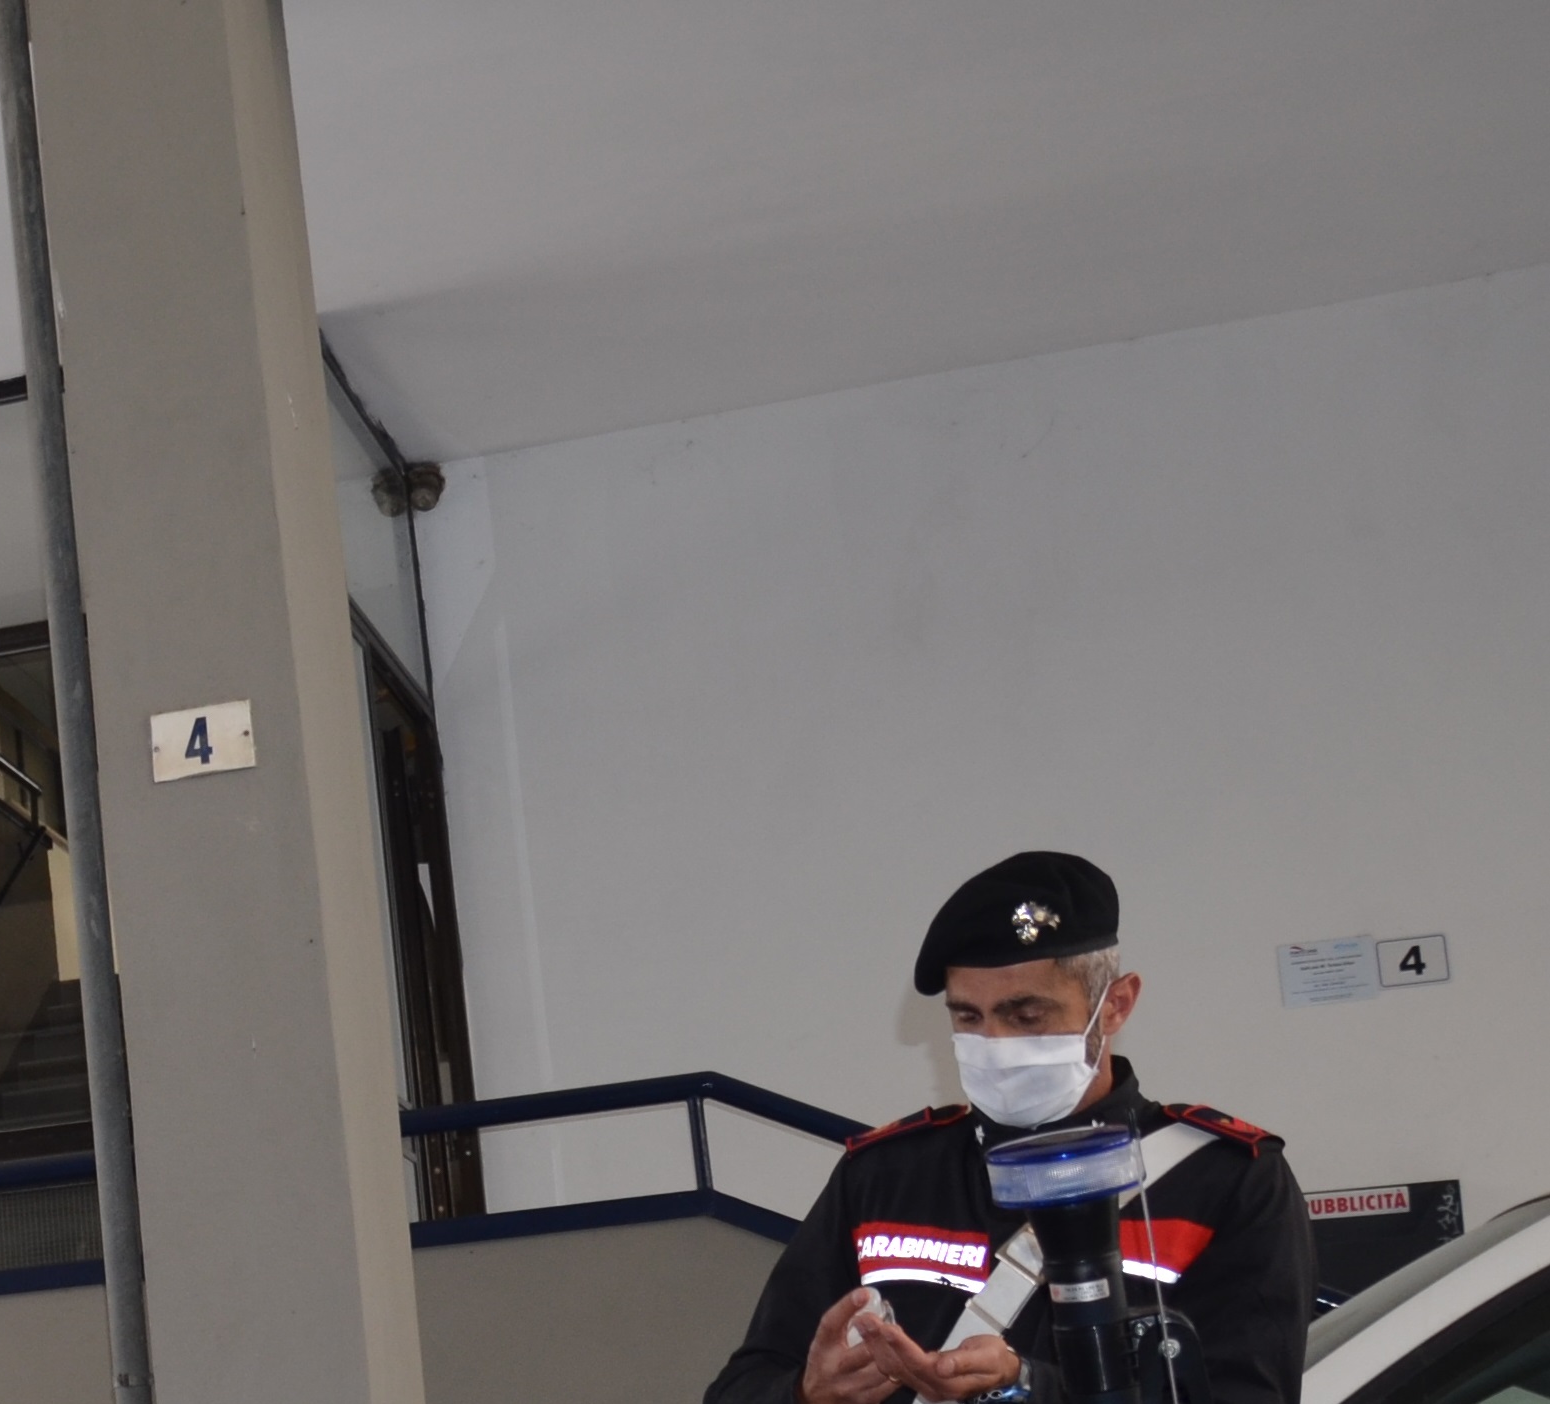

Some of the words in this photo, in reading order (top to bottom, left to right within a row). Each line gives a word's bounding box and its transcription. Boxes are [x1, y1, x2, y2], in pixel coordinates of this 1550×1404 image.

[185, 716, 213, 765] 4
[1399, 944, 1426, 975] 4
[1306, 1189, 1408, 1215] UBBLICITÀ
